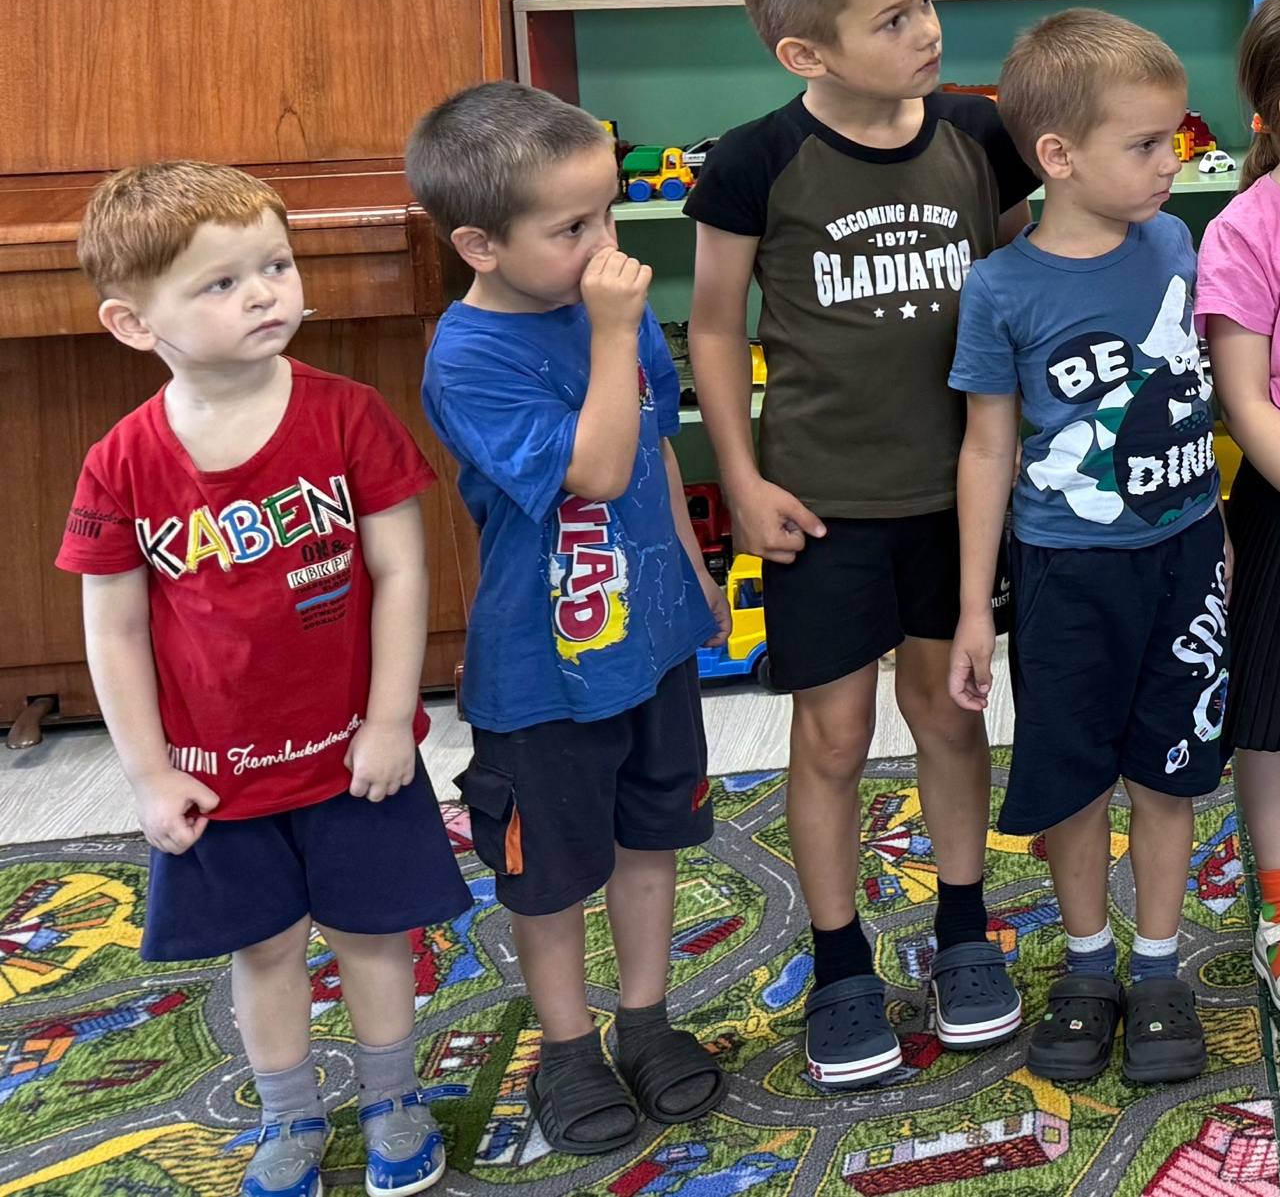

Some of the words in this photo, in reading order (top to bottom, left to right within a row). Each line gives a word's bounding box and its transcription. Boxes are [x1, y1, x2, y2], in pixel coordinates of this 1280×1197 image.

[825, 204, 905, 241] BECOMING
[908, 204, 920, 222] A
[923, 204, 958, 229] HERO
[813, 239, 971, 307] GLADIATOR
[1048, 340, 1130, 398] BE
[134, 474, 356, 581] KABEN
